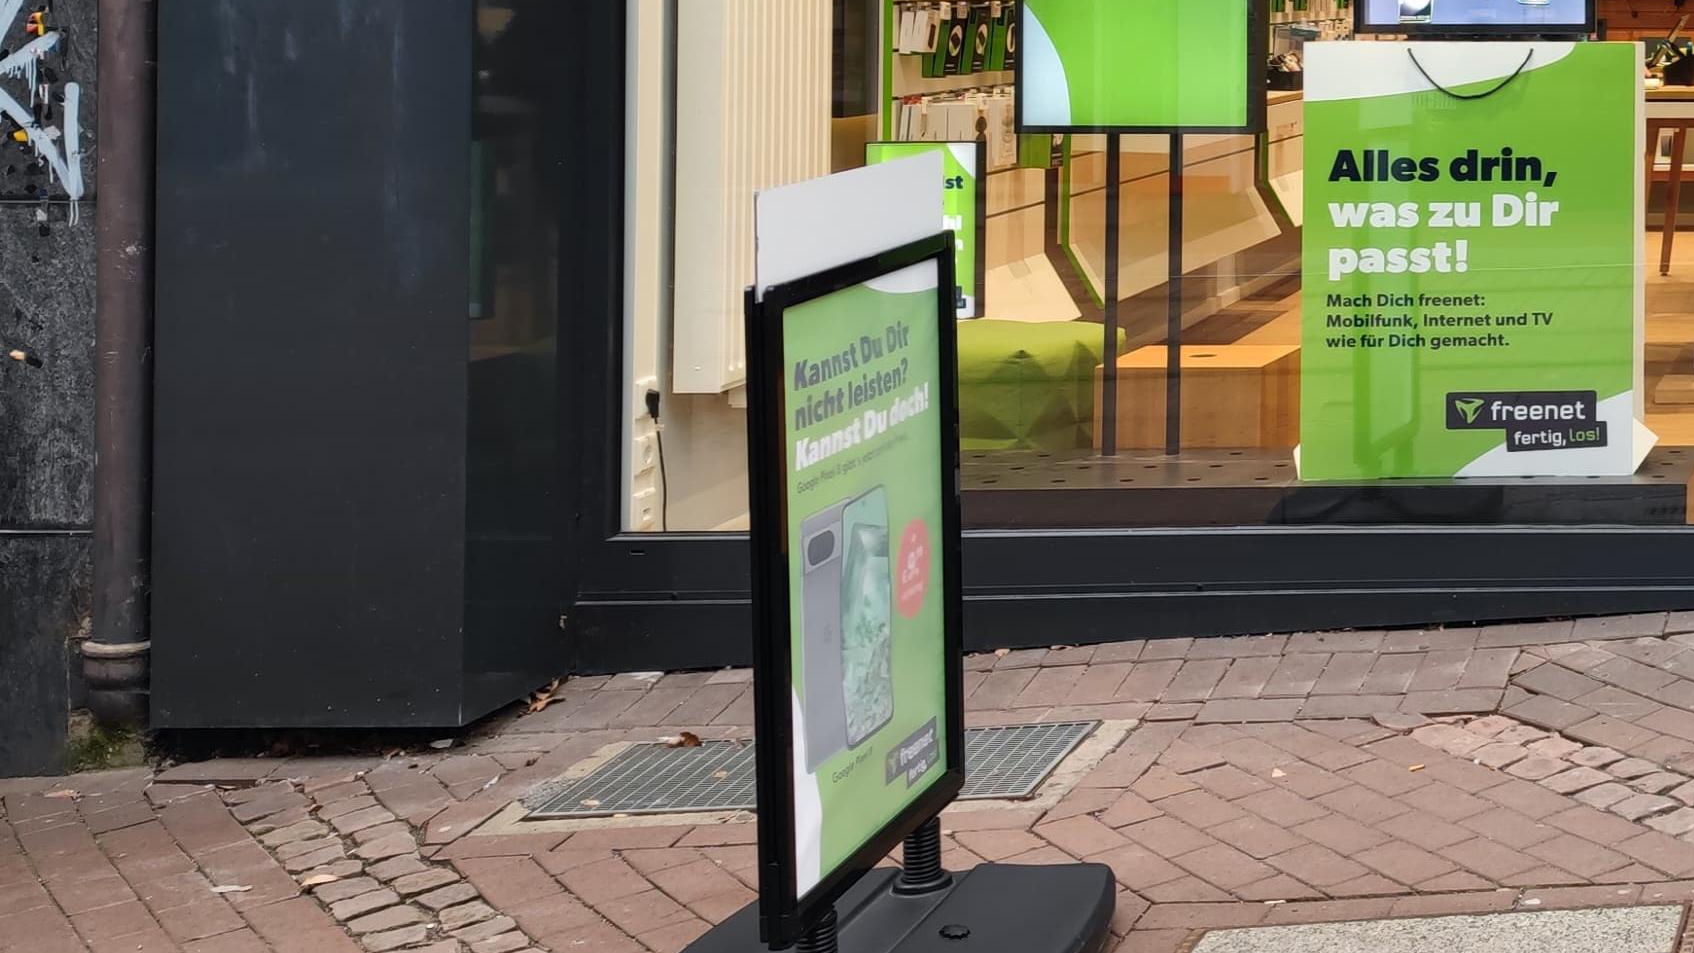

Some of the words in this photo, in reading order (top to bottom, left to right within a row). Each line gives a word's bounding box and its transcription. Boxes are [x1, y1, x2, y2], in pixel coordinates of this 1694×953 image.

[1328, 149, 1440, 183] Alles
[1449, 146, 1559, 188] drin,
[1328, 199, 1419, 228] was
[1428, 201, 1481, 228] zu
[1492, 191, 1560, 227] Dir
[1328, 239, 1468, 281] passt!
[1326, 293, 1372, 308] Mach
[1377, 293, 1414, 307] Dich
[1418, 292, 1486, 307] freenet:
[1326, 313, 1418, 330] Mobilfunk,
[1423, 312, 1491, 327] Internet
[1495, 311, 1528, 326] und
[1532, 312, 1553, 326] TV
[794, 342, 858, 391] Kannst
[860, 335, 884, 365] Du
[886, 320, 909, 353] Dir
[1326, 334, 1356, 348] wie
[1360, 334, 1384, 348] für
[1388, 333, 1426, 348] Dich
[1430, 333, 1510, 350] gemacht.
[795, 387, 844, 431] nicht
[848, 357, 908, 409] leisten?
[1491, 400, 1586, 421] freenet
[796, 416, 861, 471] Kannst
[864, 409, 888, 440] Du
[1514, 428, 1567, 447] fertig,
[1569, 427, 1600, 443] los!
